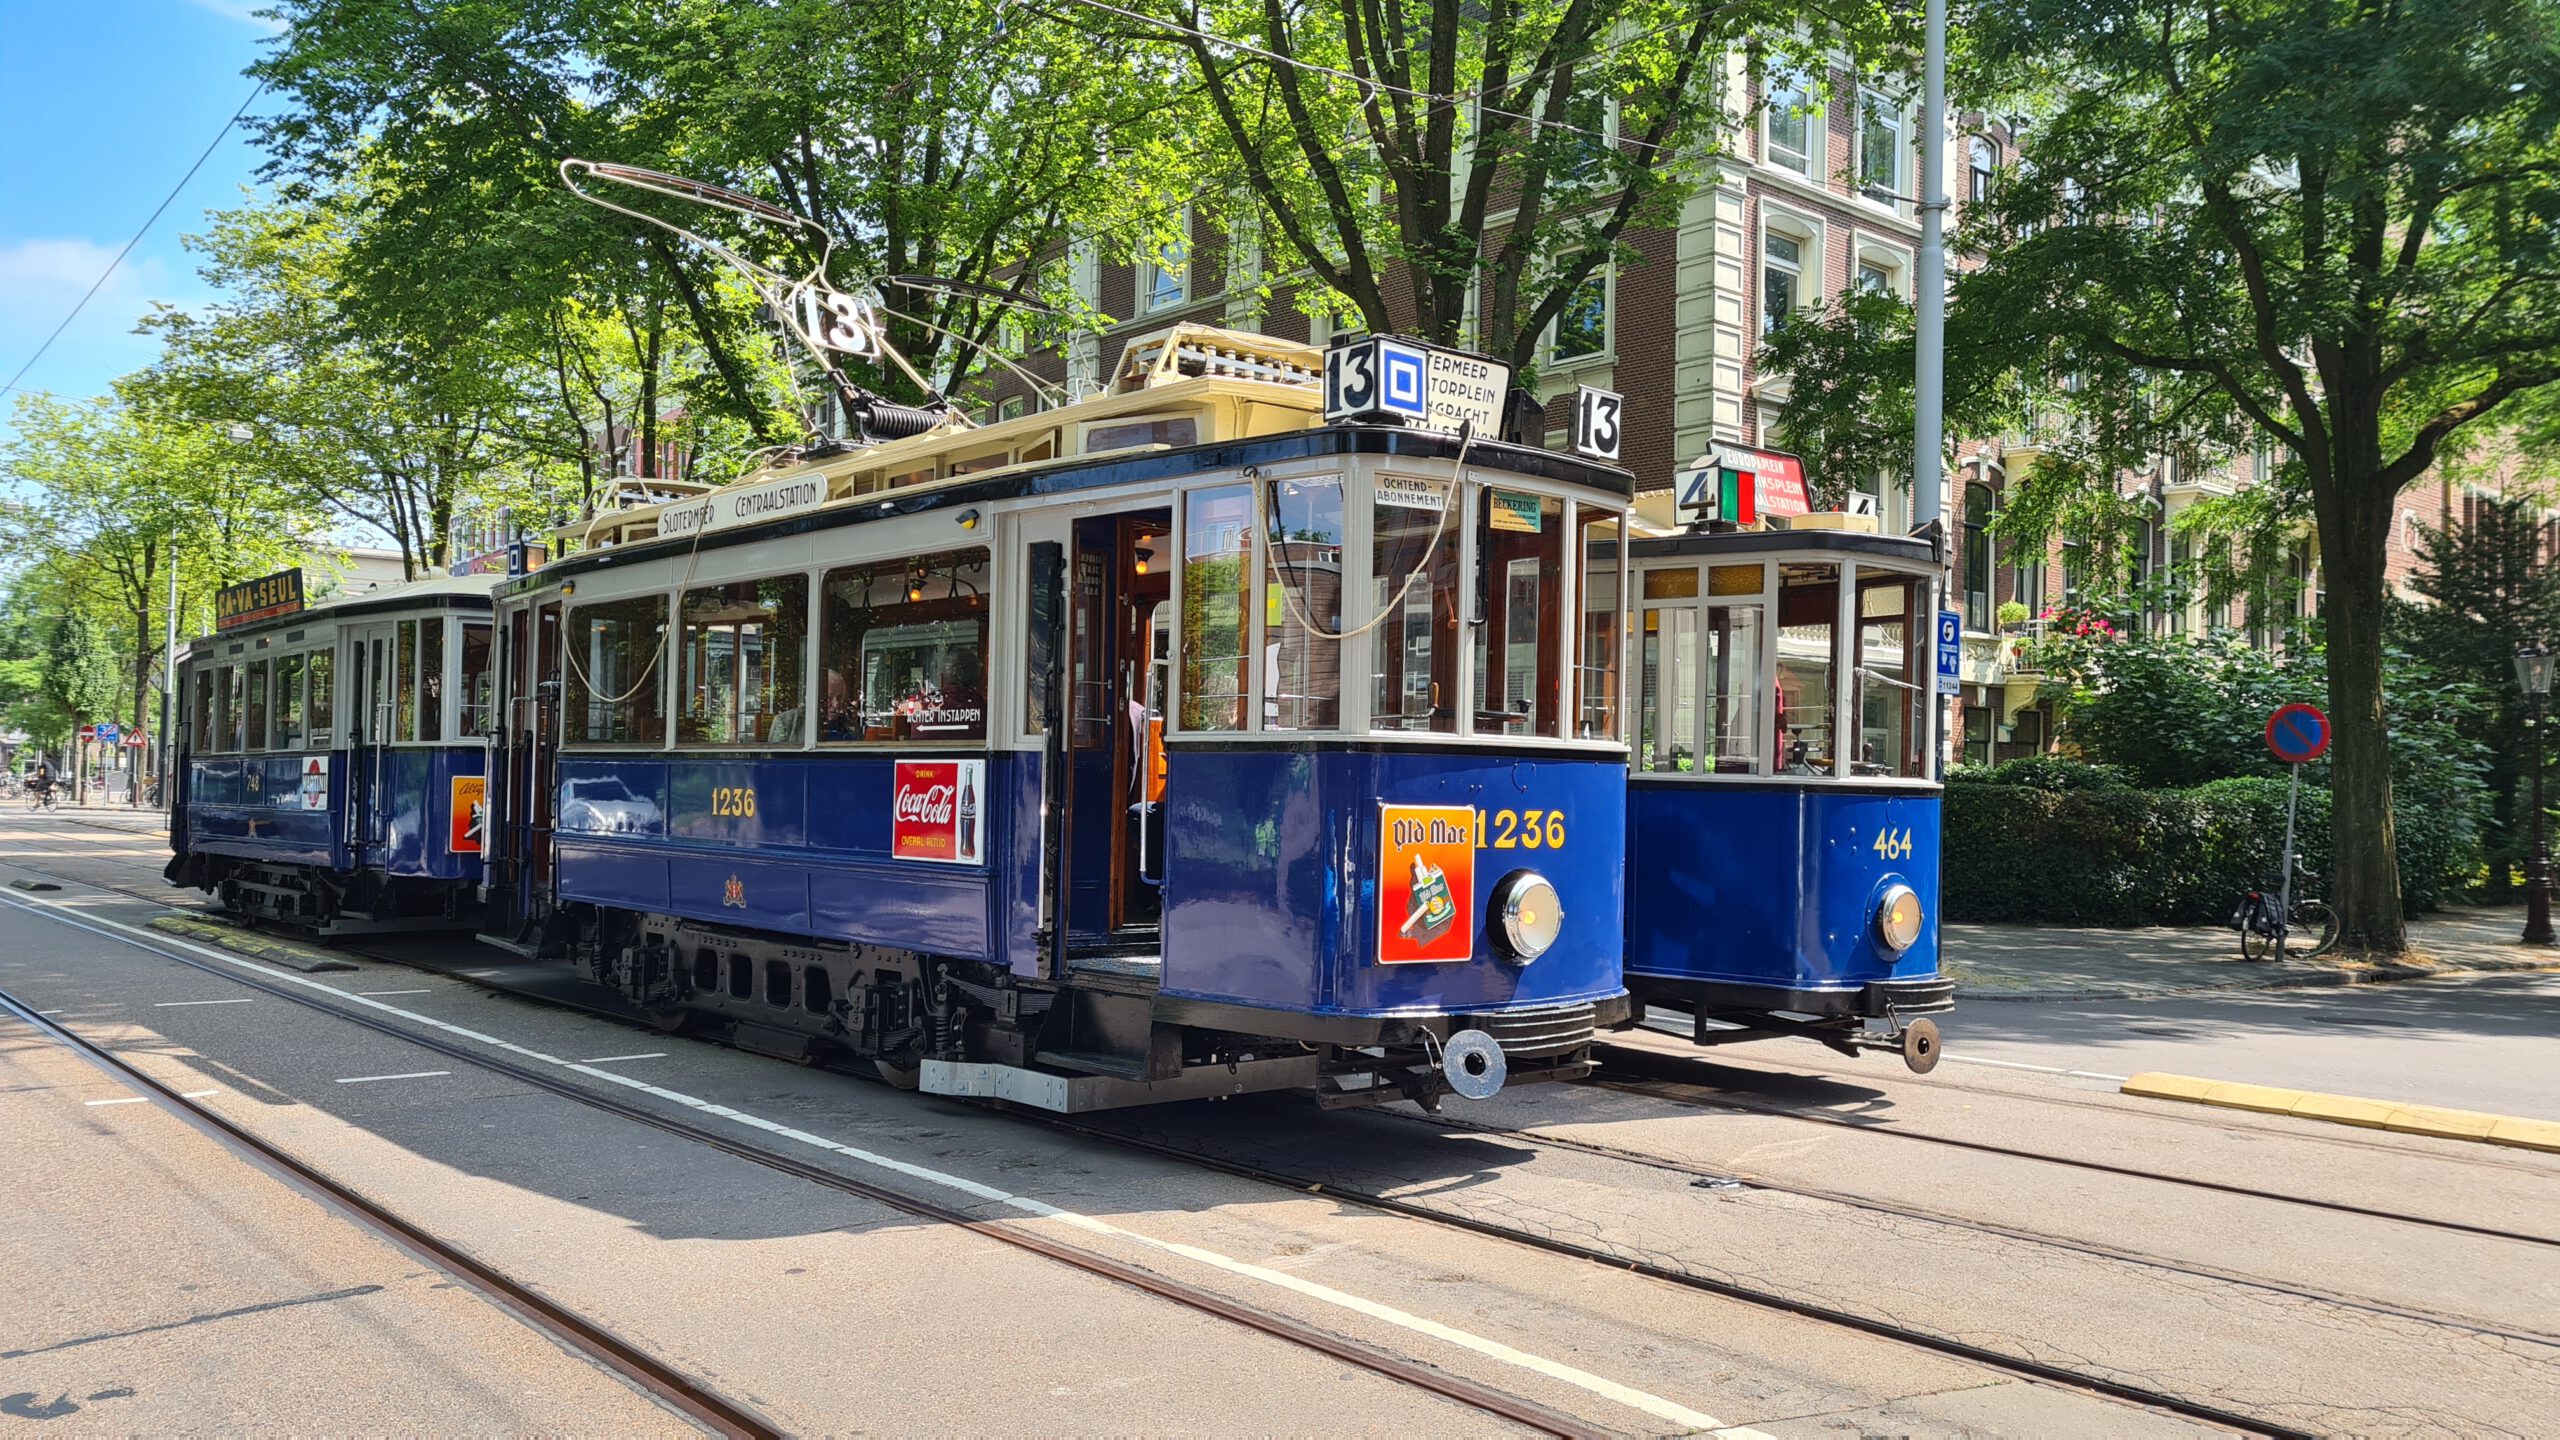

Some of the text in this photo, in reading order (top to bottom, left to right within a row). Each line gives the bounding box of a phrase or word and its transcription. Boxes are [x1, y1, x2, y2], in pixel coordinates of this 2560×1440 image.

[803, 287, 866, 352] 13
[1326, 343, 1374, 413] 13
[1580, 392, 1619, 453] 13
[1726, 449, 1785, 474] EUROPAPLEIN
[663, 482, 817, 534] SLOTERMEER CENTRAALSTATION
[1377, 490, 1442, 507] ABONNEMENT
[1493, 497, 1536, 513] BECKERING
[1679, 471, 1716, 521] 4
[907, 708, 981, 723] ACHTER INSTAPPEN
[916, 769, 934, 778] DRINK
[712, 787, 755, 817] 1236
[896, 783, 955, 825] Coca-Cola
[1393, 816, 1467, 852] Old Mac
[1475, 809, 1566, 849] 1236
[1873, 827, 1912, 860] 464
